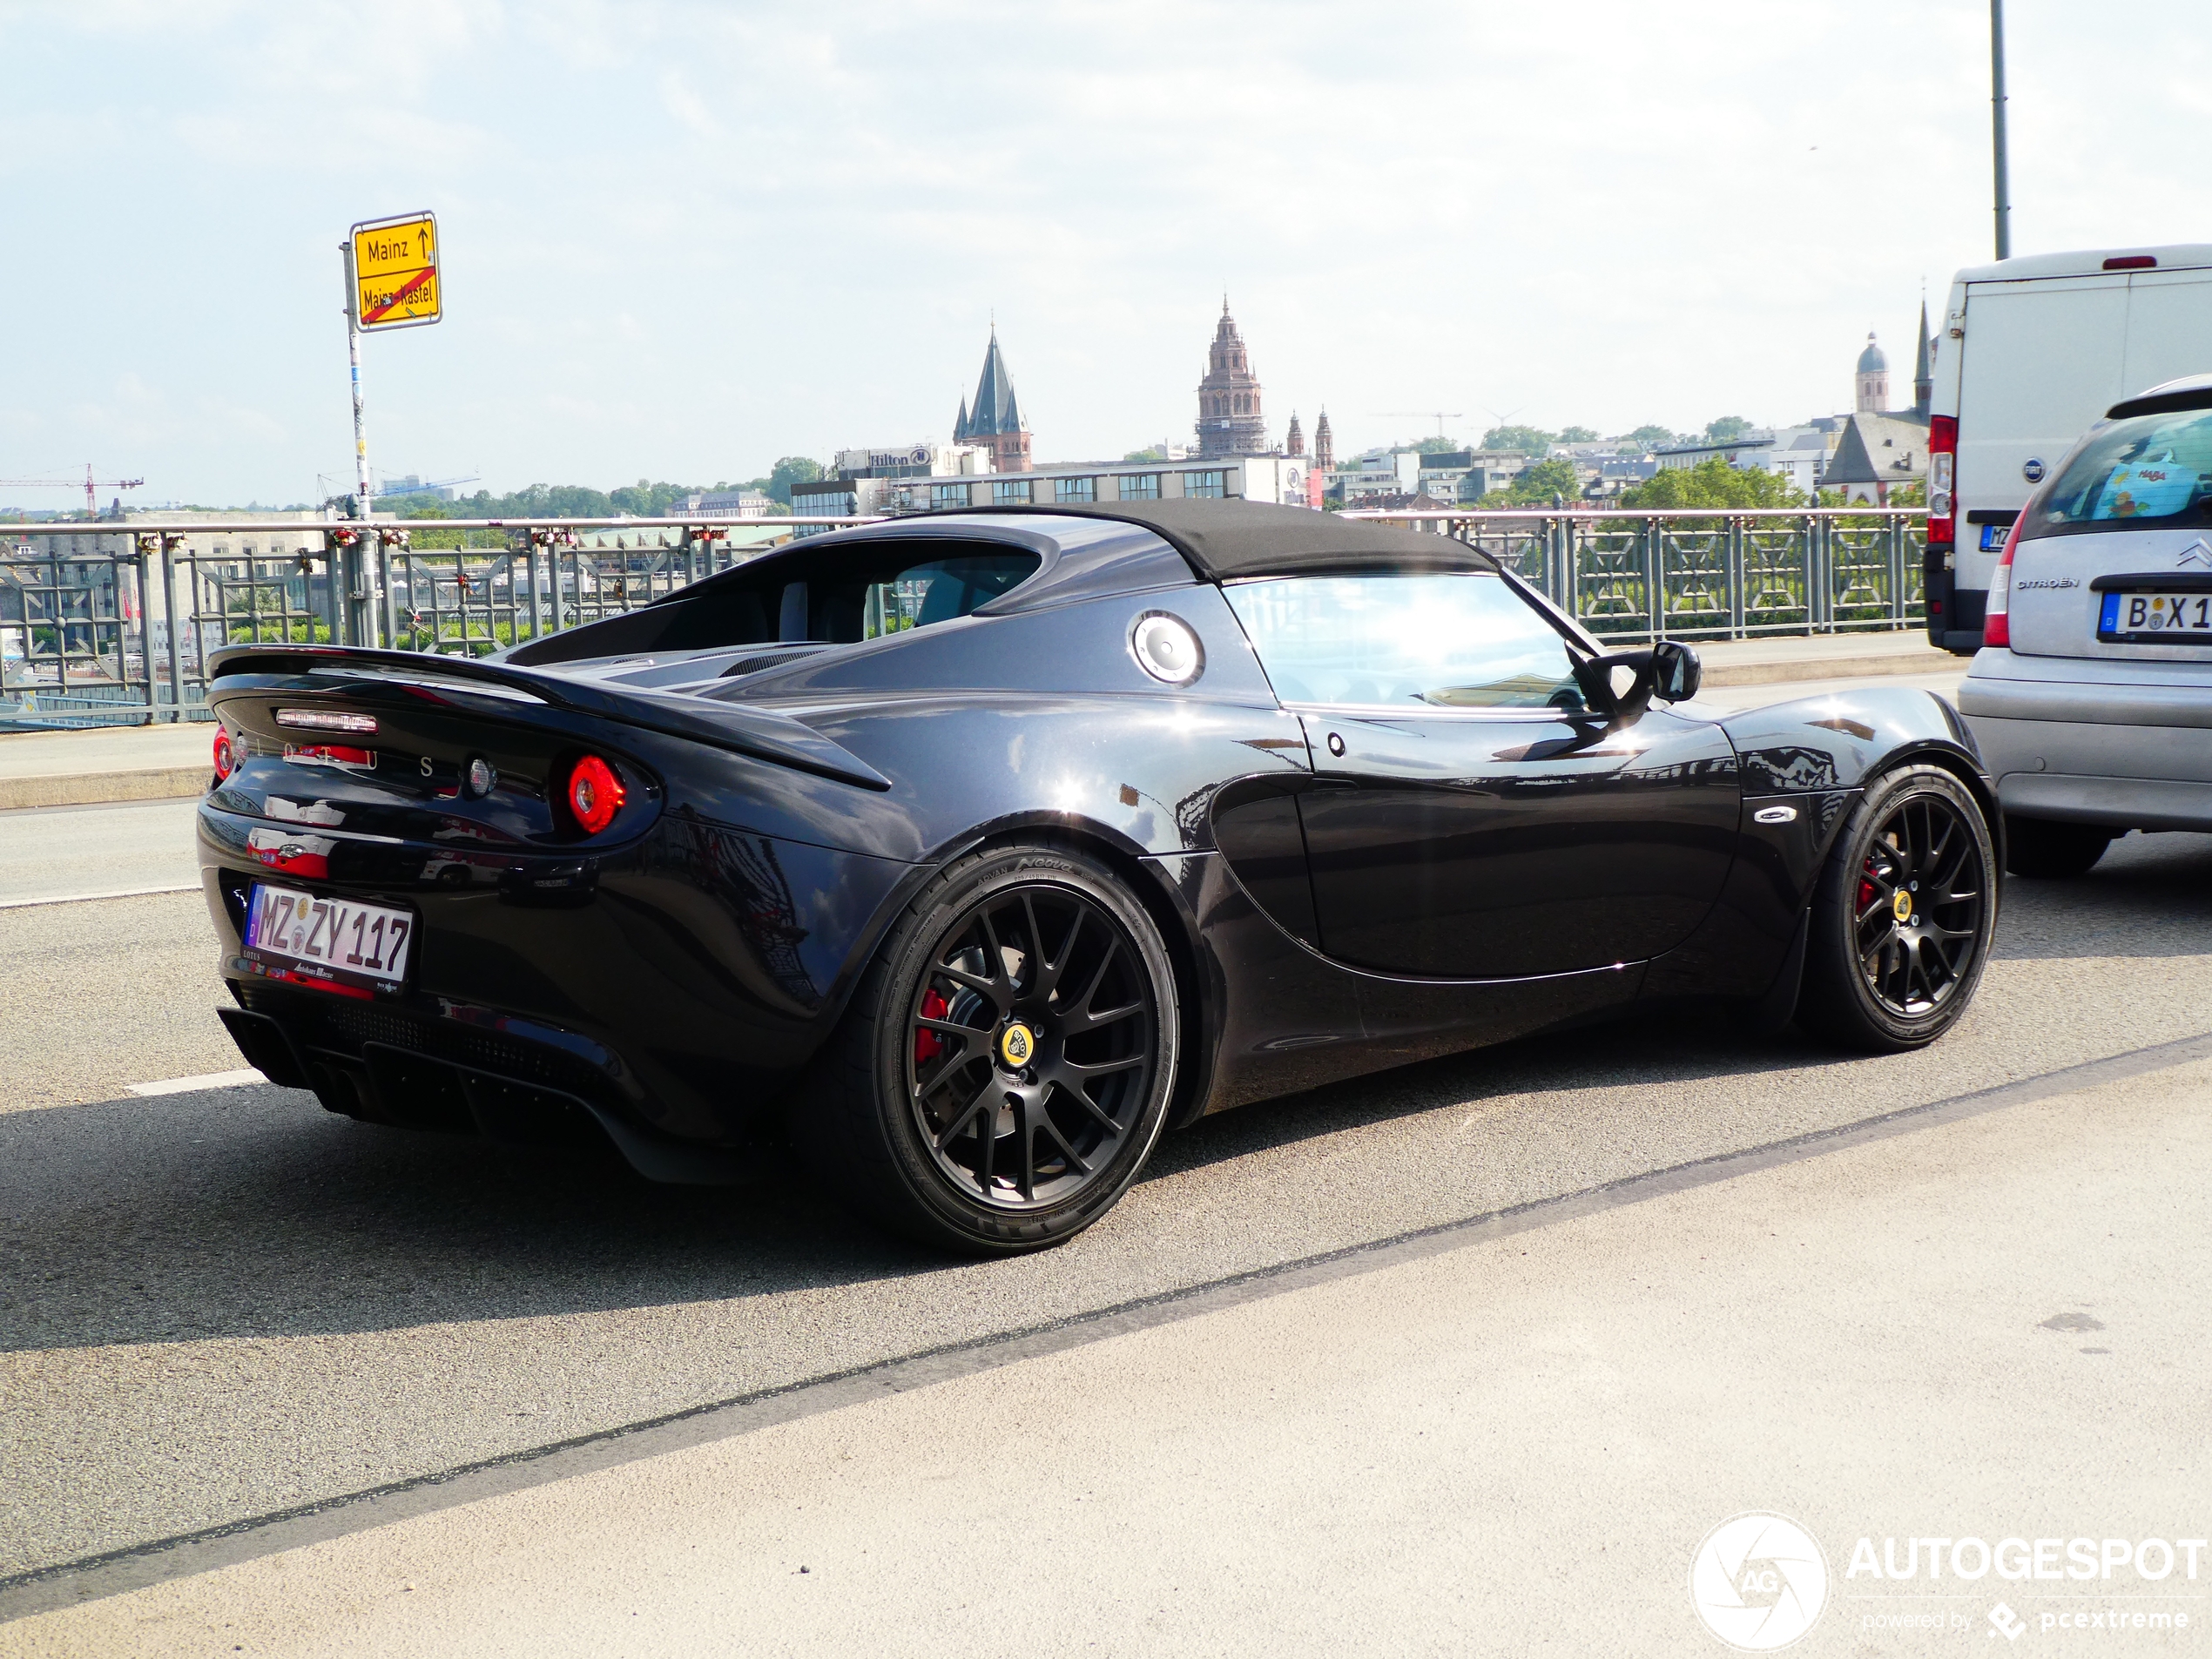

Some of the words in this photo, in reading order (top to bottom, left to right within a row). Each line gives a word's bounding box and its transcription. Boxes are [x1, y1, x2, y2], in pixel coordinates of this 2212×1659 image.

[368, 239, 408, 262] Mainz
[871, 454, 908, 467] Hilton
[2026, 466, 2041, 475] FIAT
[2138, 470, 2166, 482] HABA
[1991, 528, 2012, 544] MZ
[2017, 577, 2079, 589] CITROËN
[2128, 597, 2147, 627] B
[976, 867, 1008, 887] ADVAN
[258, 894, 295, 948] MZ
[305, 902, 347, 958] ZY
[347, 911, 409, 972] 117
[243, 950, 260, 961] LOTUS
[1014, 1030, 1026, 1056] LOTUS
